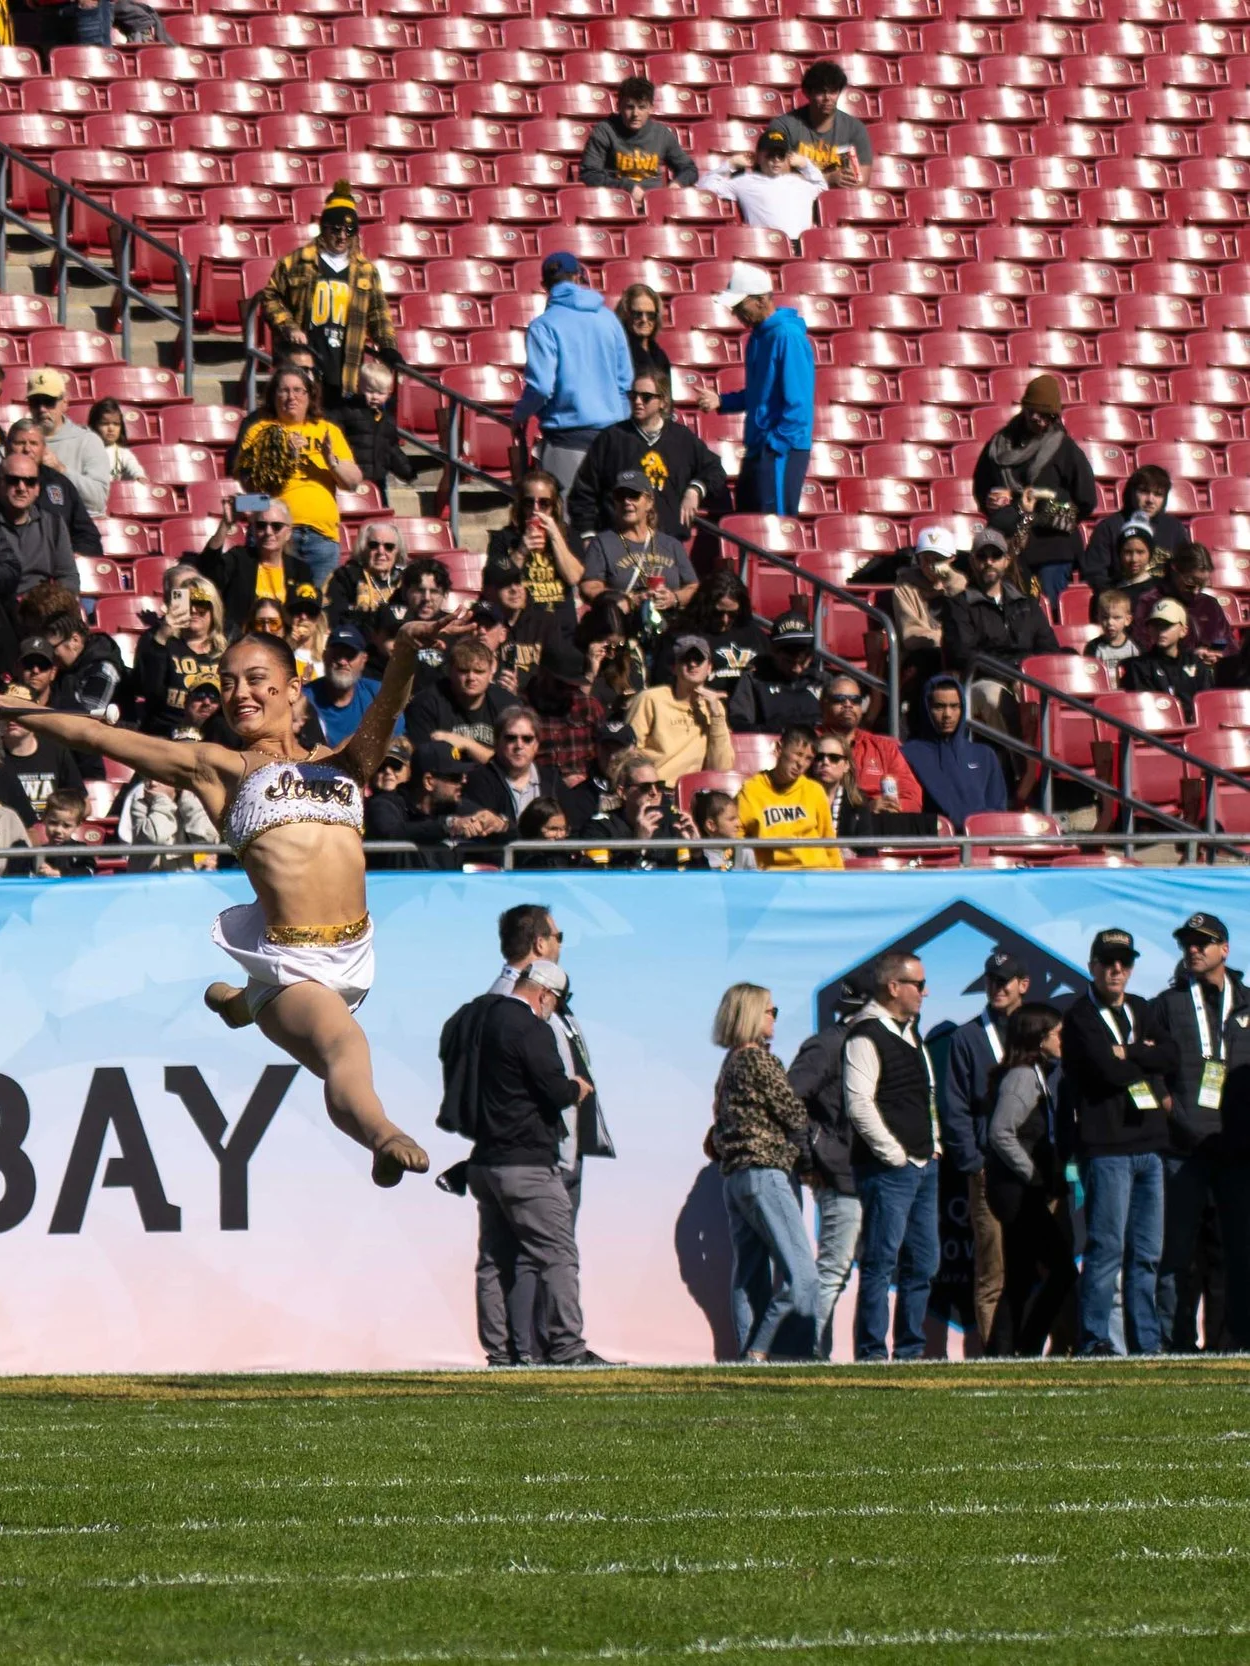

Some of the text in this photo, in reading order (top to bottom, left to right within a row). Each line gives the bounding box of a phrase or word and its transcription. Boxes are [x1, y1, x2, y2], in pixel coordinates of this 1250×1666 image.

[616, 151, 660, 172] IOWA
[264, 769, 353, 807] Iowa
[763, 805, 807, 829] IOWA
